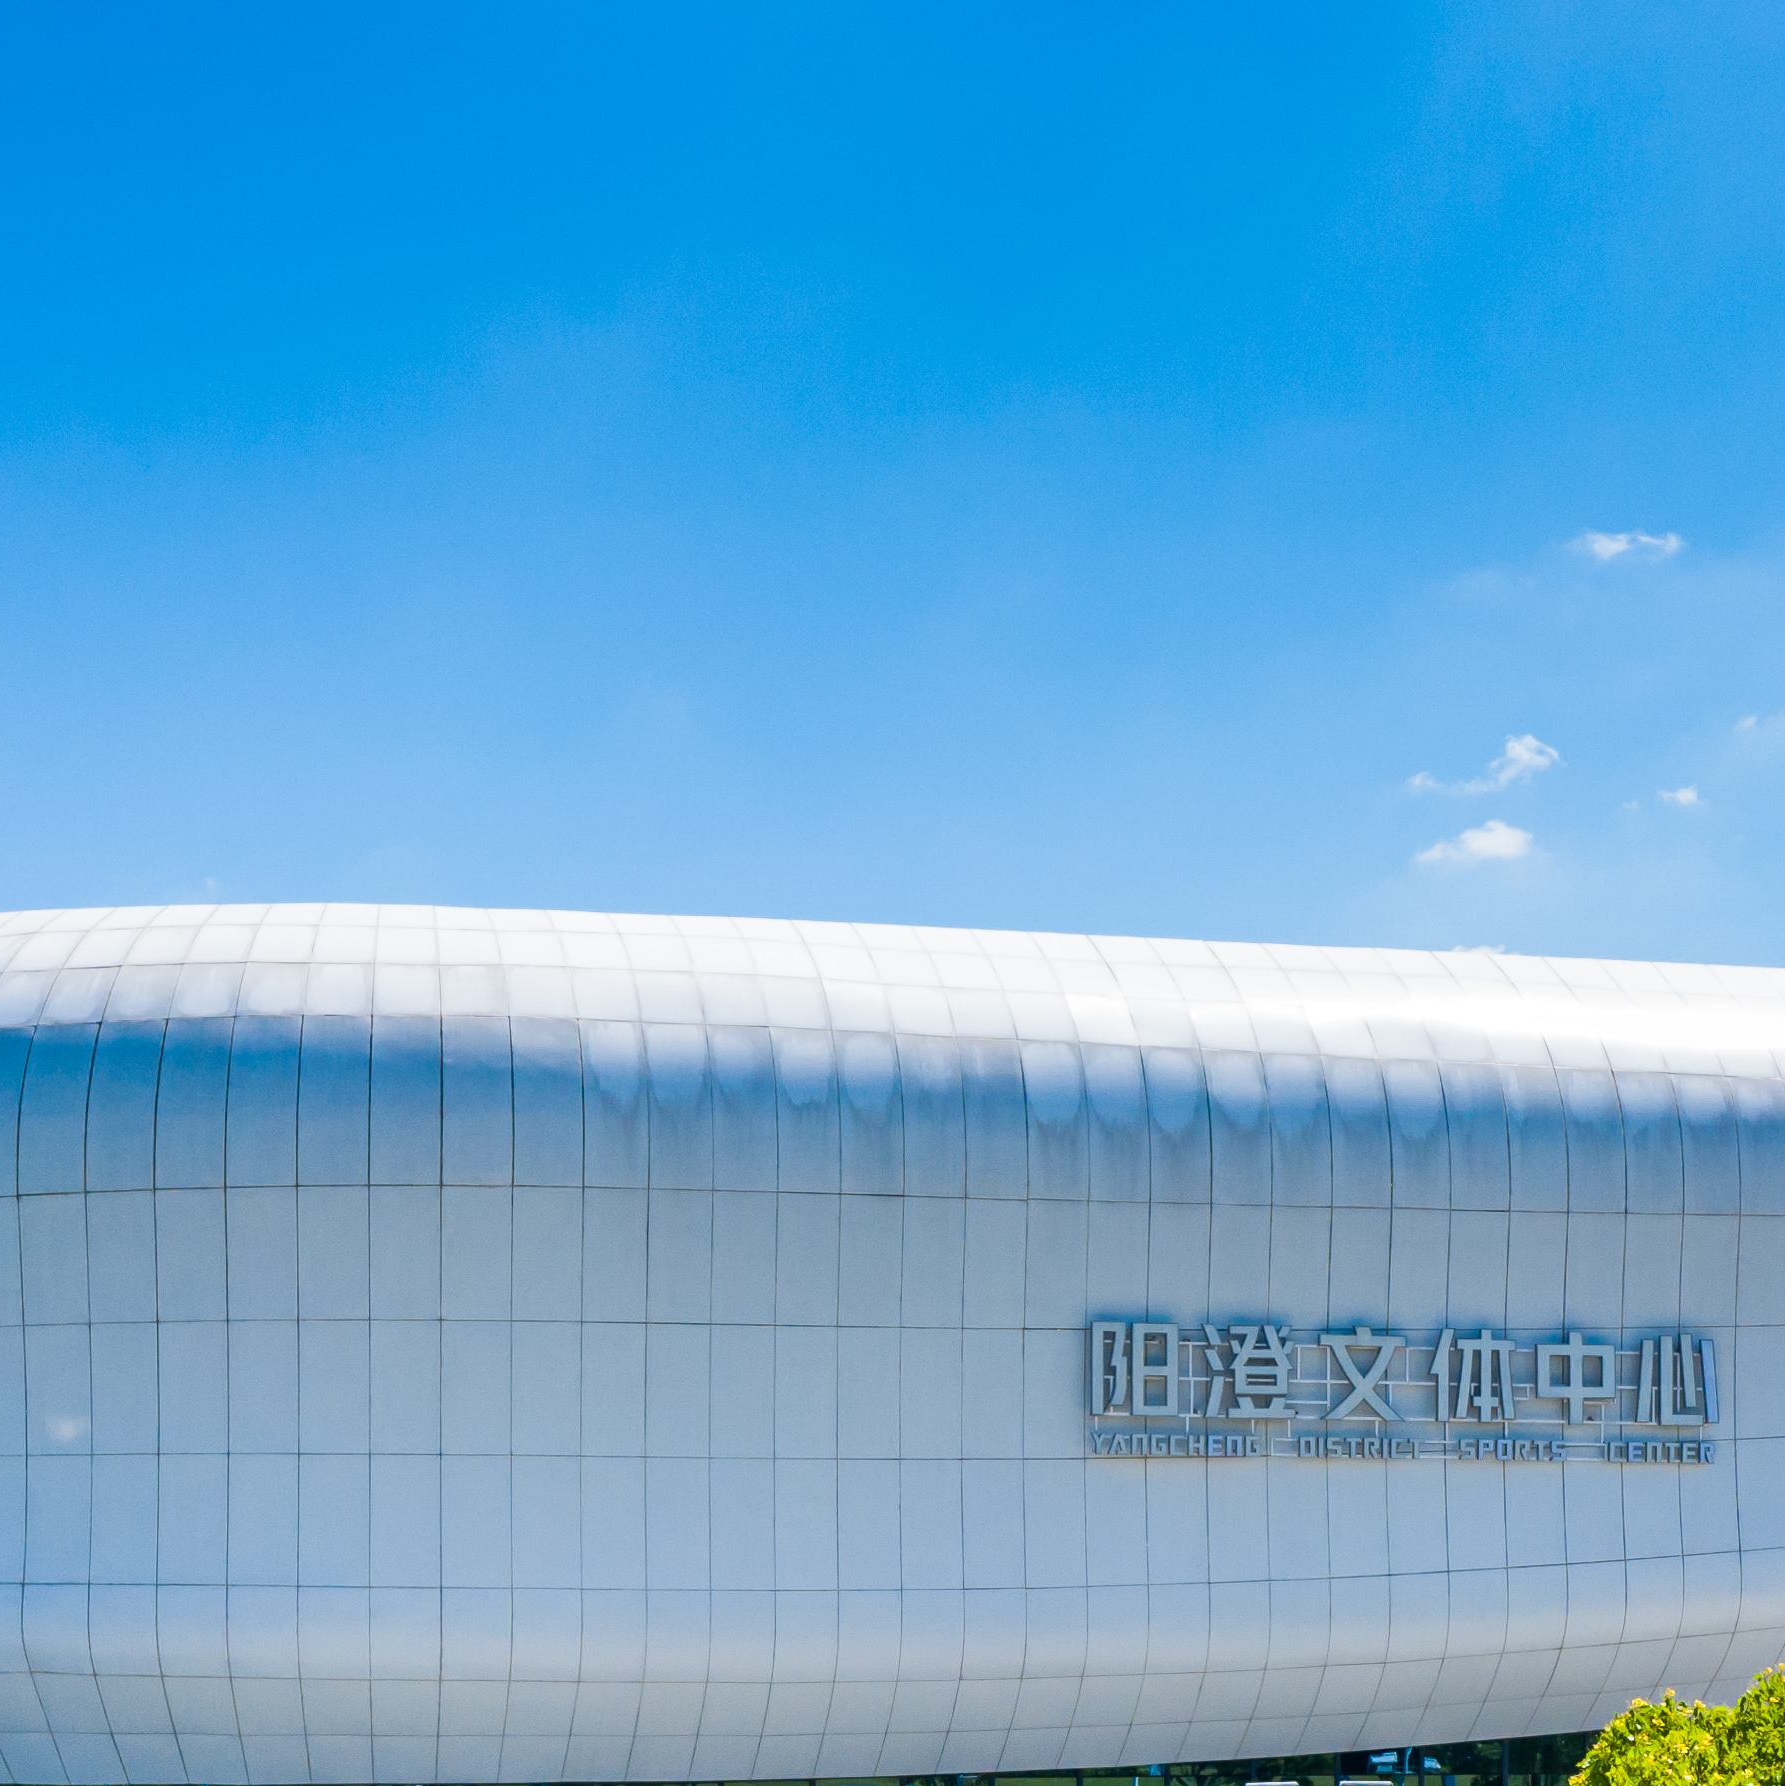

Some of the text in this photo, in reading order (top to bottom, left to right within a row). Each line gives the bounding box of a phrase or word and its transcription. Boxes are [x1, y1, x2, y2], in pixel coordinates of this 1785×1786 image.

[1090, 1320, 1720, 1426] 阳澄文体中心
[1090, 1432, 1714, 1464] YANGCHENG DISTRICT SPORTS CENTER
